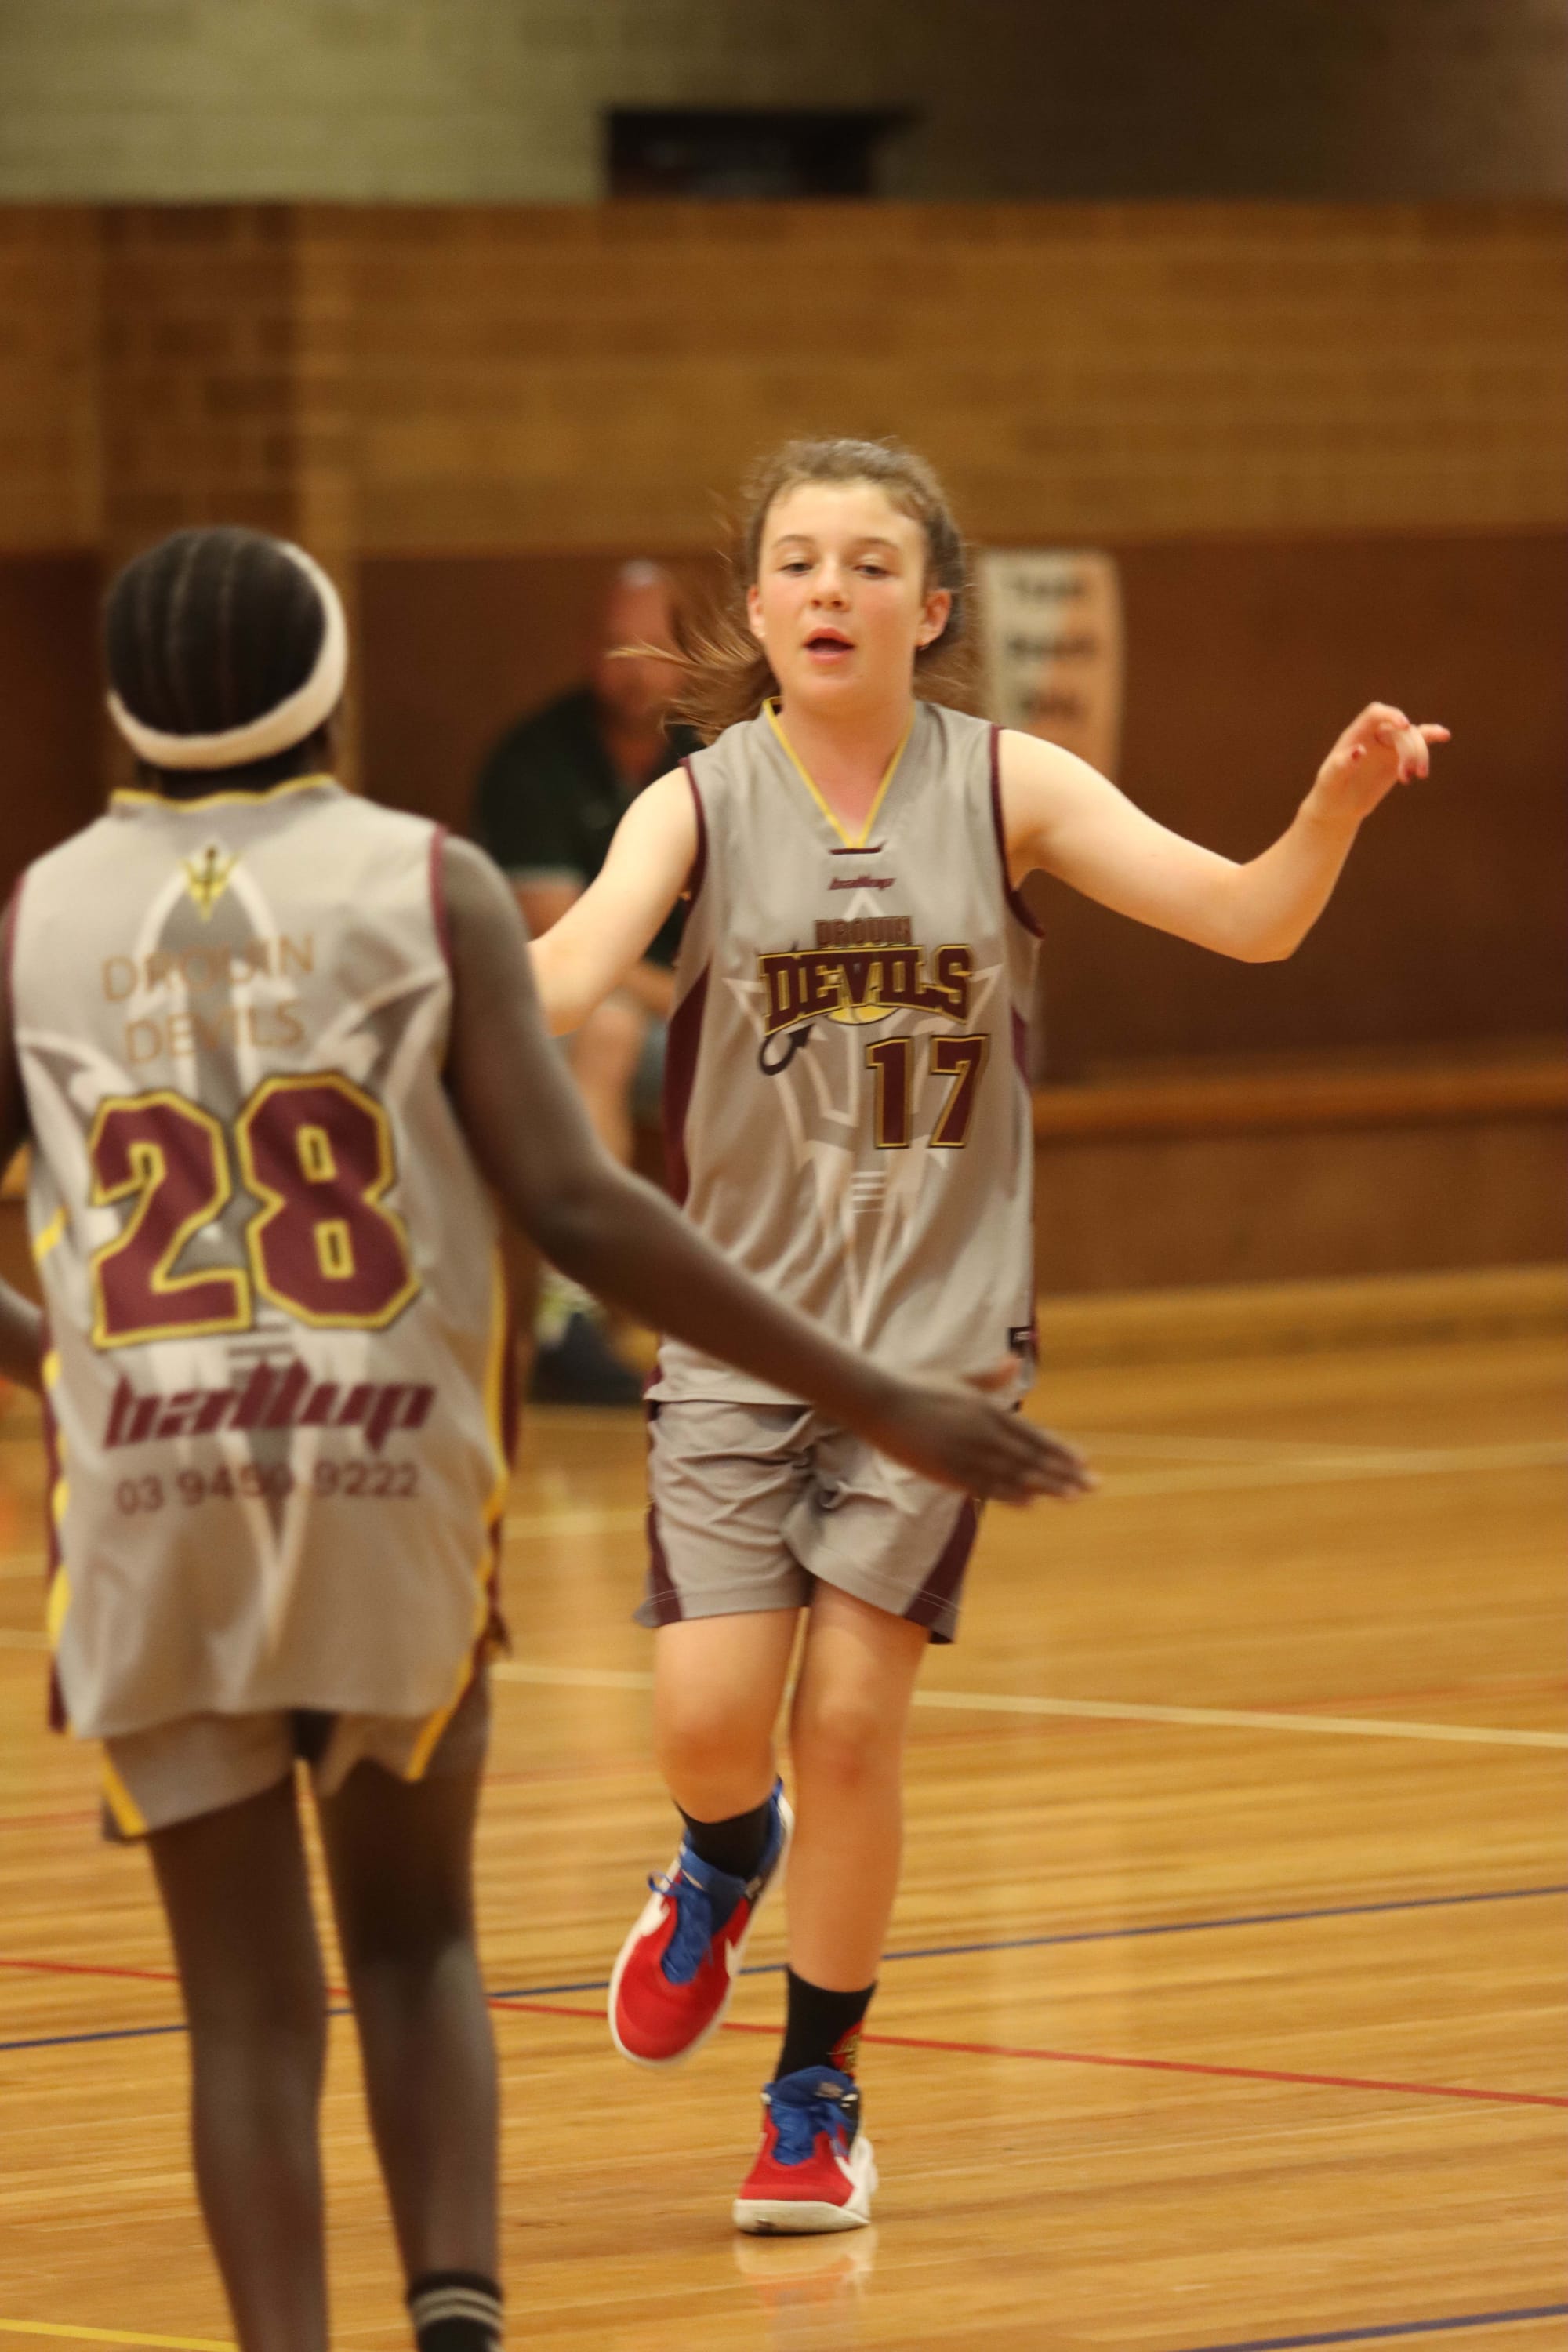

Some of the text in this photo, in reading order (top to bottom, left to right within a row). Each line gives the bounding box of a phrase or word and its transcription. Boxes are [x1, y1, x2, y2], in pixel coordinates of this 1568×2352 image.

[101, 933, 313, 1003] DROUIN
[757, 942, 975, 1036] DEVILS
[124, 999, 307, 1065] DEVILS
[865, 1033, 991, 1150] 17
[91, 1071, 421, 1349] 28
[114, 1475, 165, 1515] 03
[314, 1457, 419, 1498] 9222
